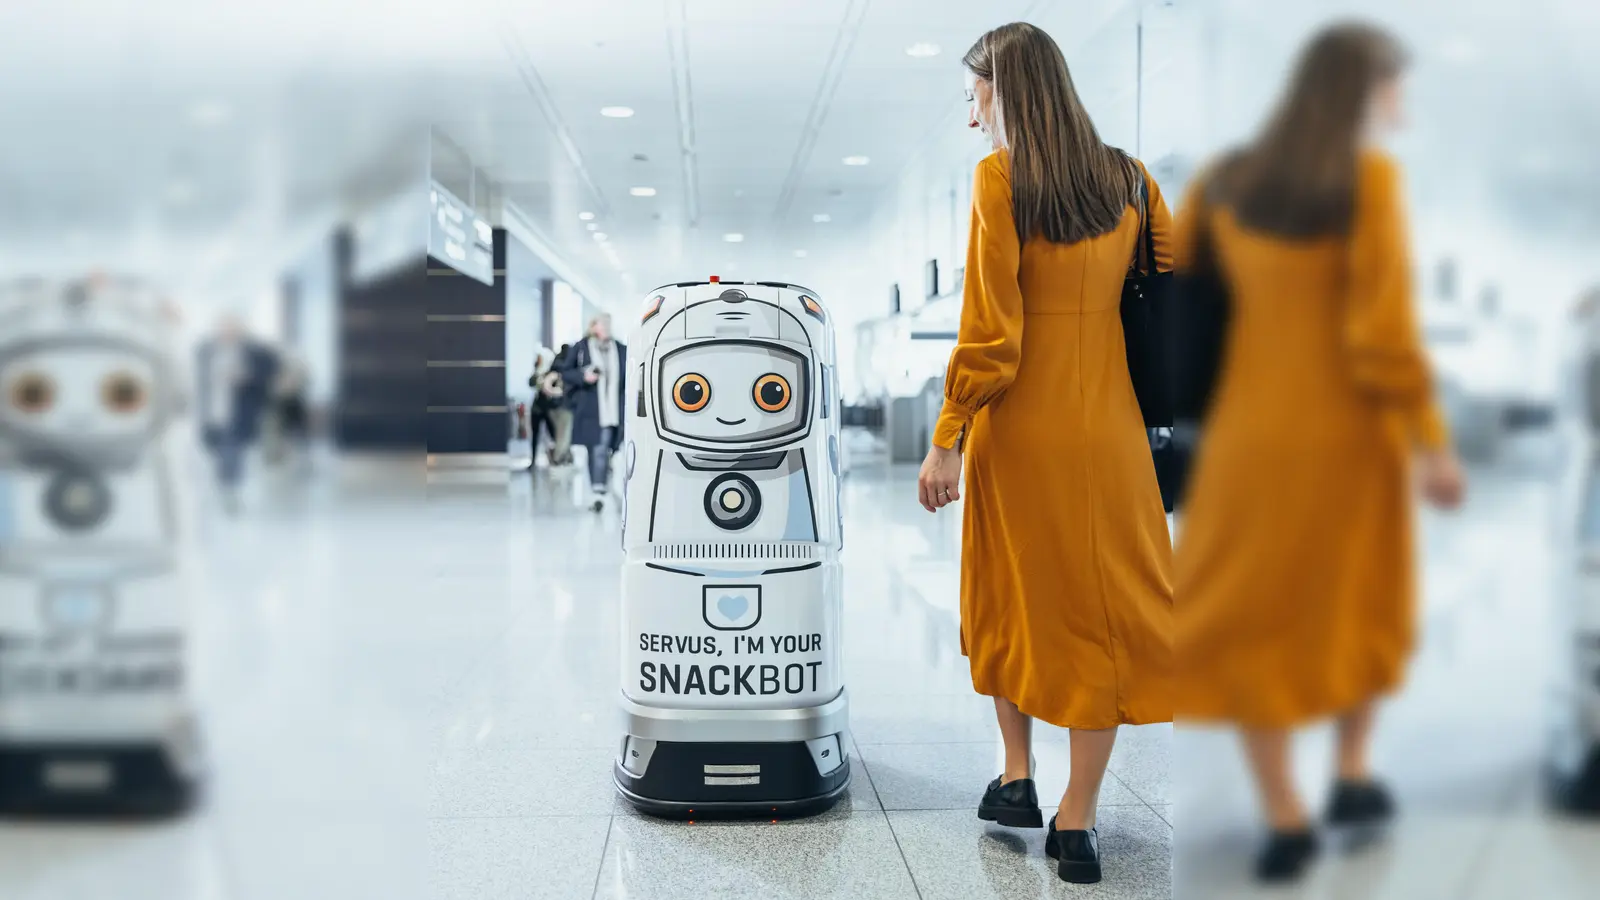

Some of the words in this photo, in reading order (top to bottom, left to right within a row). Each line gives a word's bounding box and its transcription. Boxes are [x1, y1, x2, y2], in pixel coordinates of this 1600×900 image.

[639, 633, 723, 657] SERVUS,
[734, 634, 764, 654] I'M
[770, 633, 822, 654] YOUR
[639, 661, 823, 695] SNACKBOT
